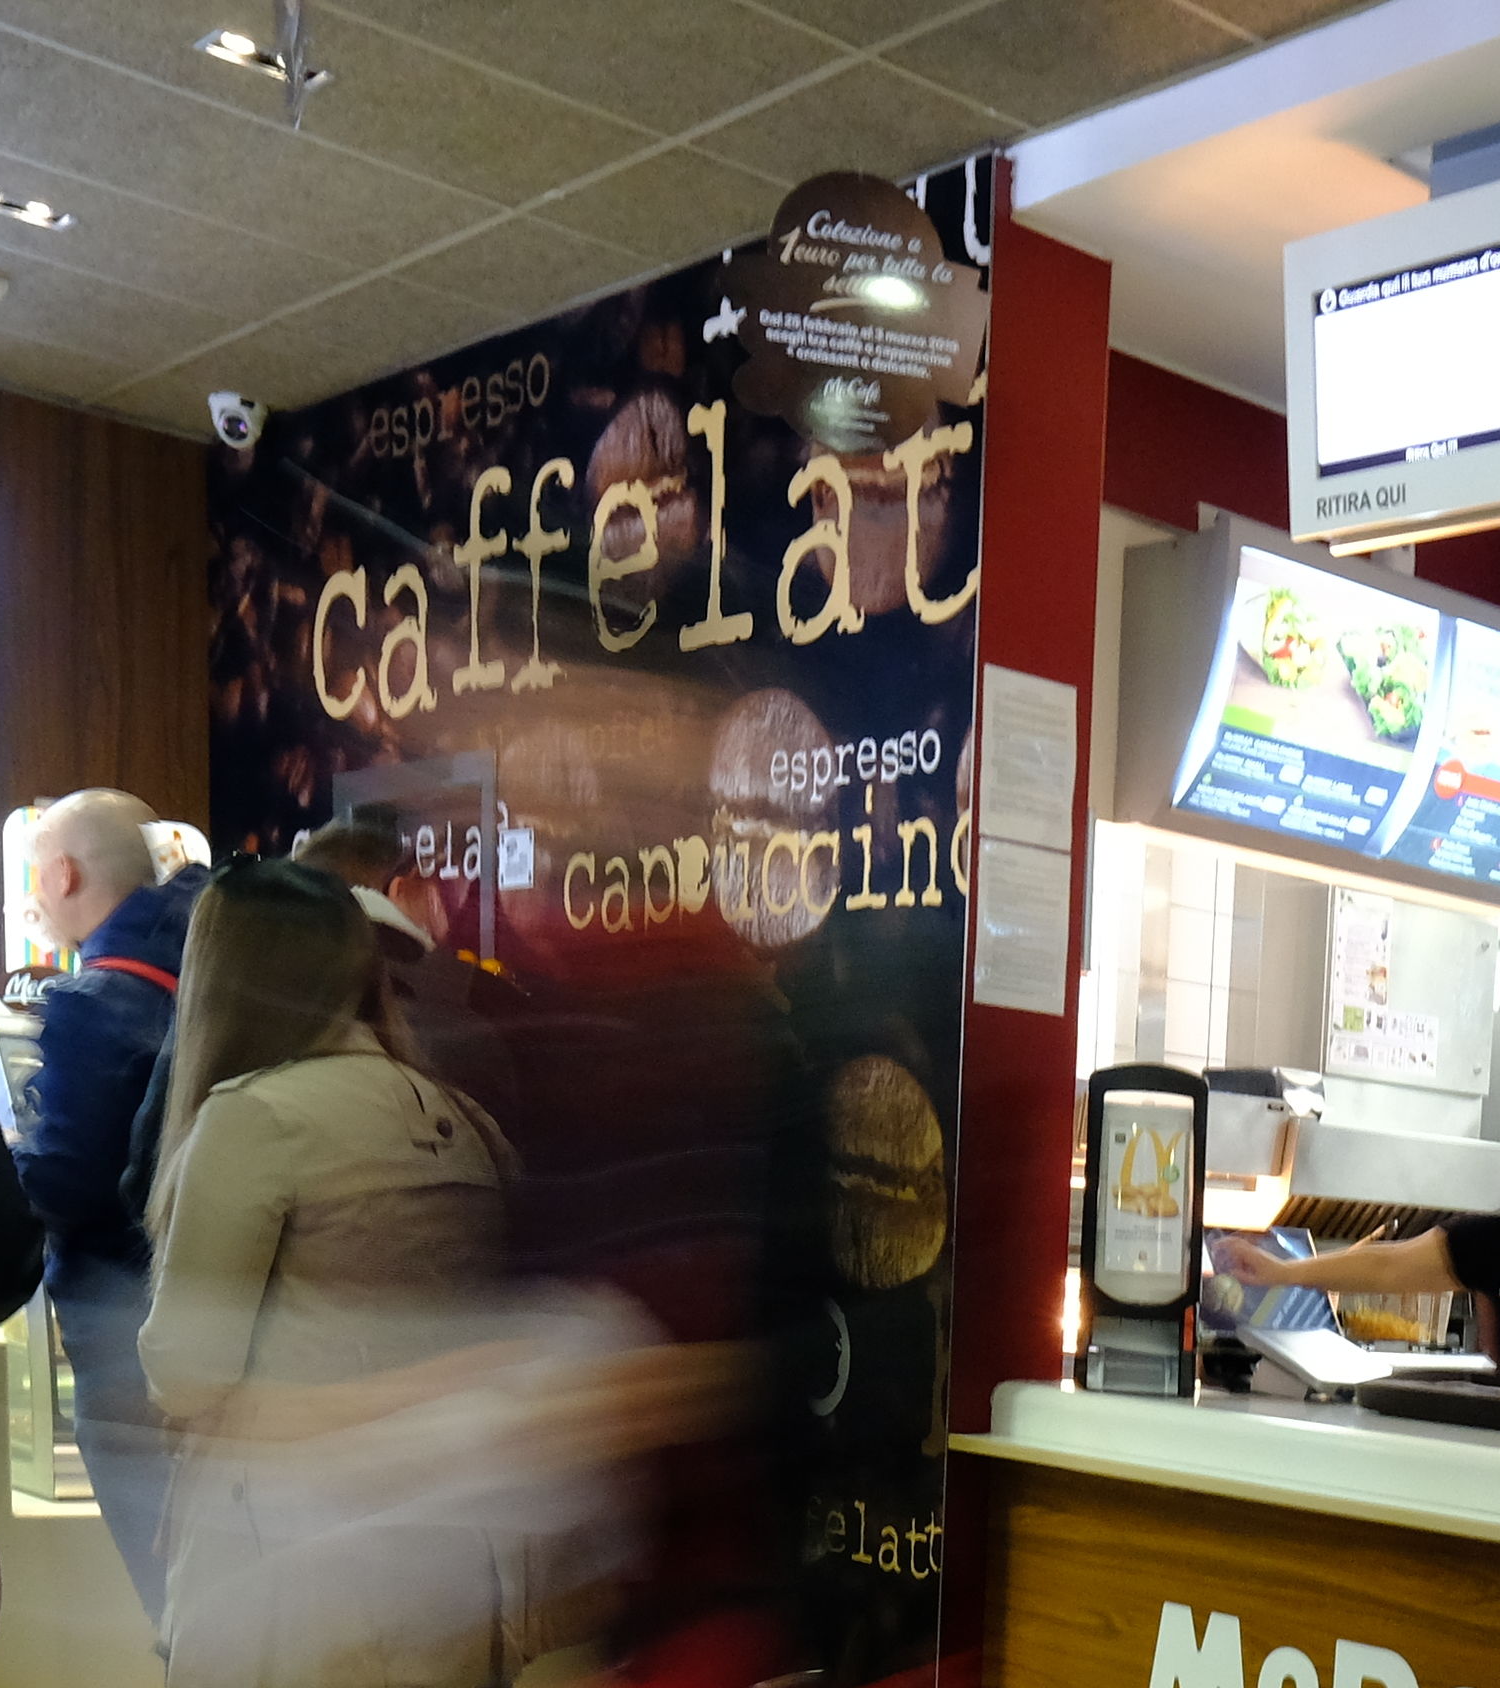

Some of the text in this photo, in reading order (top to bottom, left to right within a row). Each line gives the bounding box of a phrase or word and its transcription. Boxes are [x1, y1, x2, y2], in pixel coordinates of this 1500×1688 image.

[806, 209, 902, 249] Colazione
[843, 251, 877, 273] per
[882, 255, 925, 278] tutta
[932, 263, 953, 283] la
[370, 353, 550, 470] espresso
[1317, 484, 1406, 519] RITIRA QUI
[314, 399, 982, 720] caffelat
[770, 729, 941, 801] espresso
[3, 973, 57, 1006] McC
